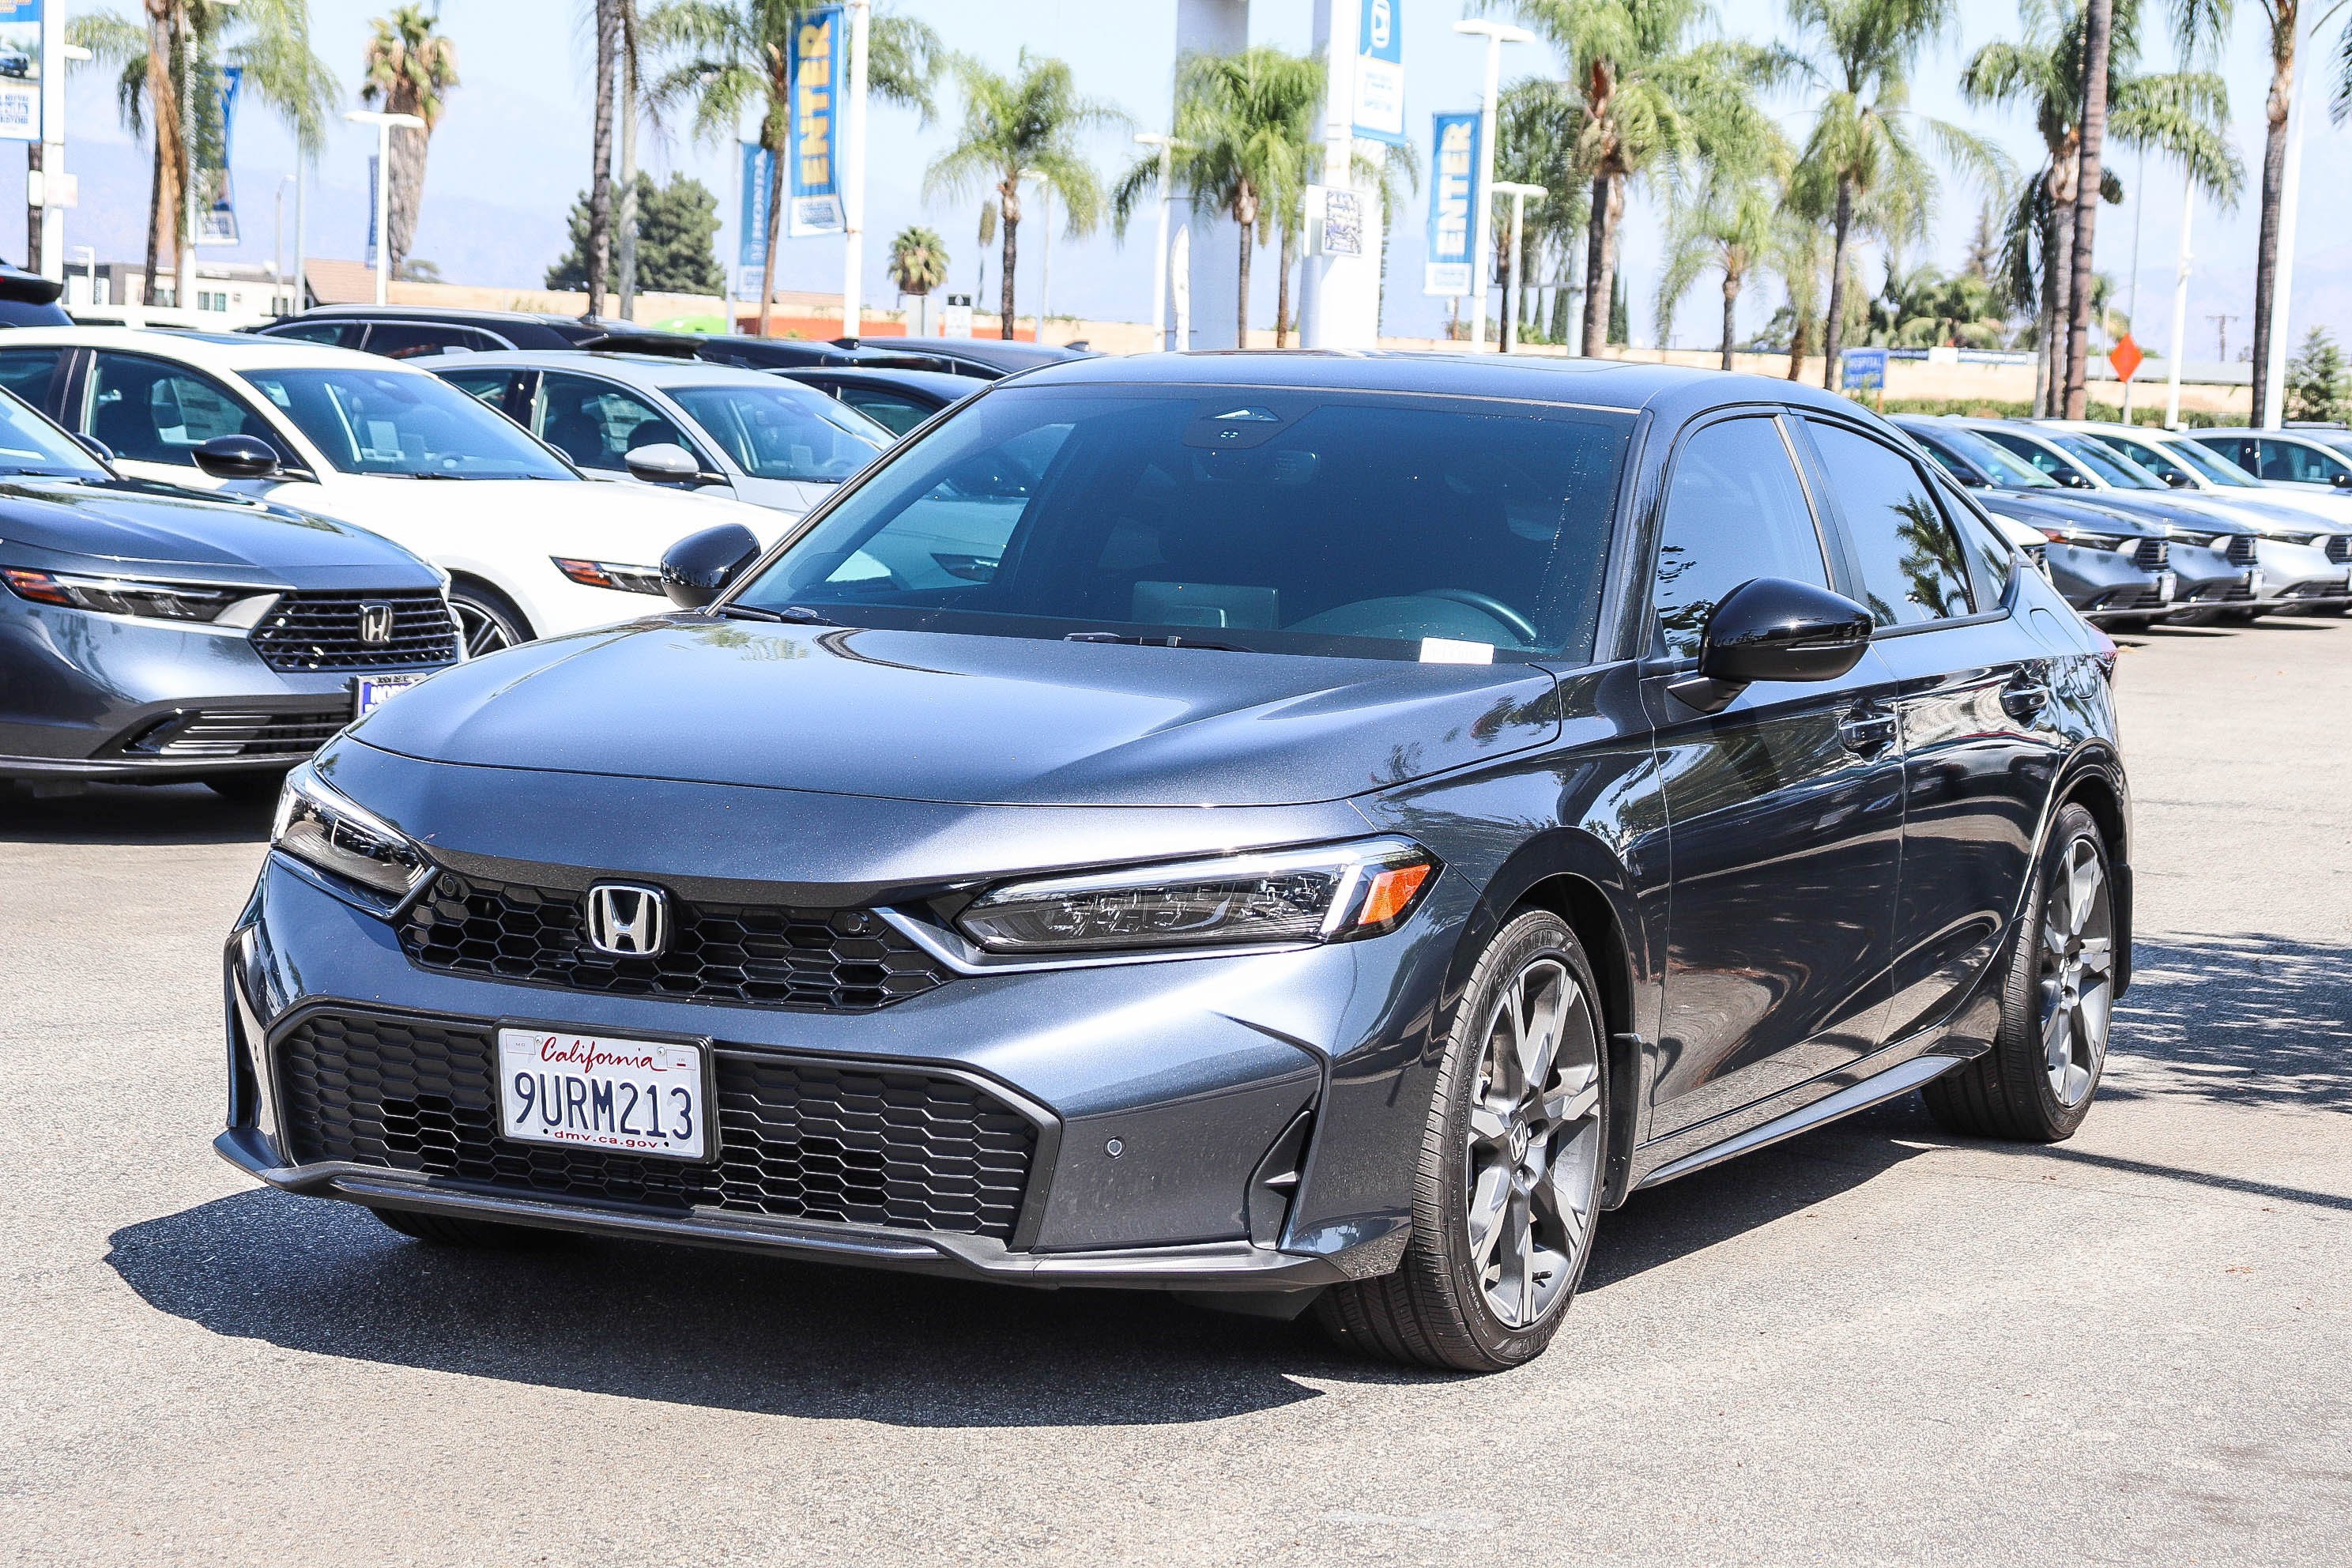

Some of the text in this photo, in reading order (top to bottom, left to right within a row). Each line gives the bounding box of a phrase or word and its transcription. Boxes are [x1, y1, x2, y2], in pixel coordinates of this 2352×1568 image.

[799, 21, 830, 187] ENTER
[1436, 121, 1471, 255] ENTER
[541, 1036, 668, 1073] California
[514, 1072, 693, 1140] 9URM213
[554, 1131, 658, 1148] dmv.ca.gov
